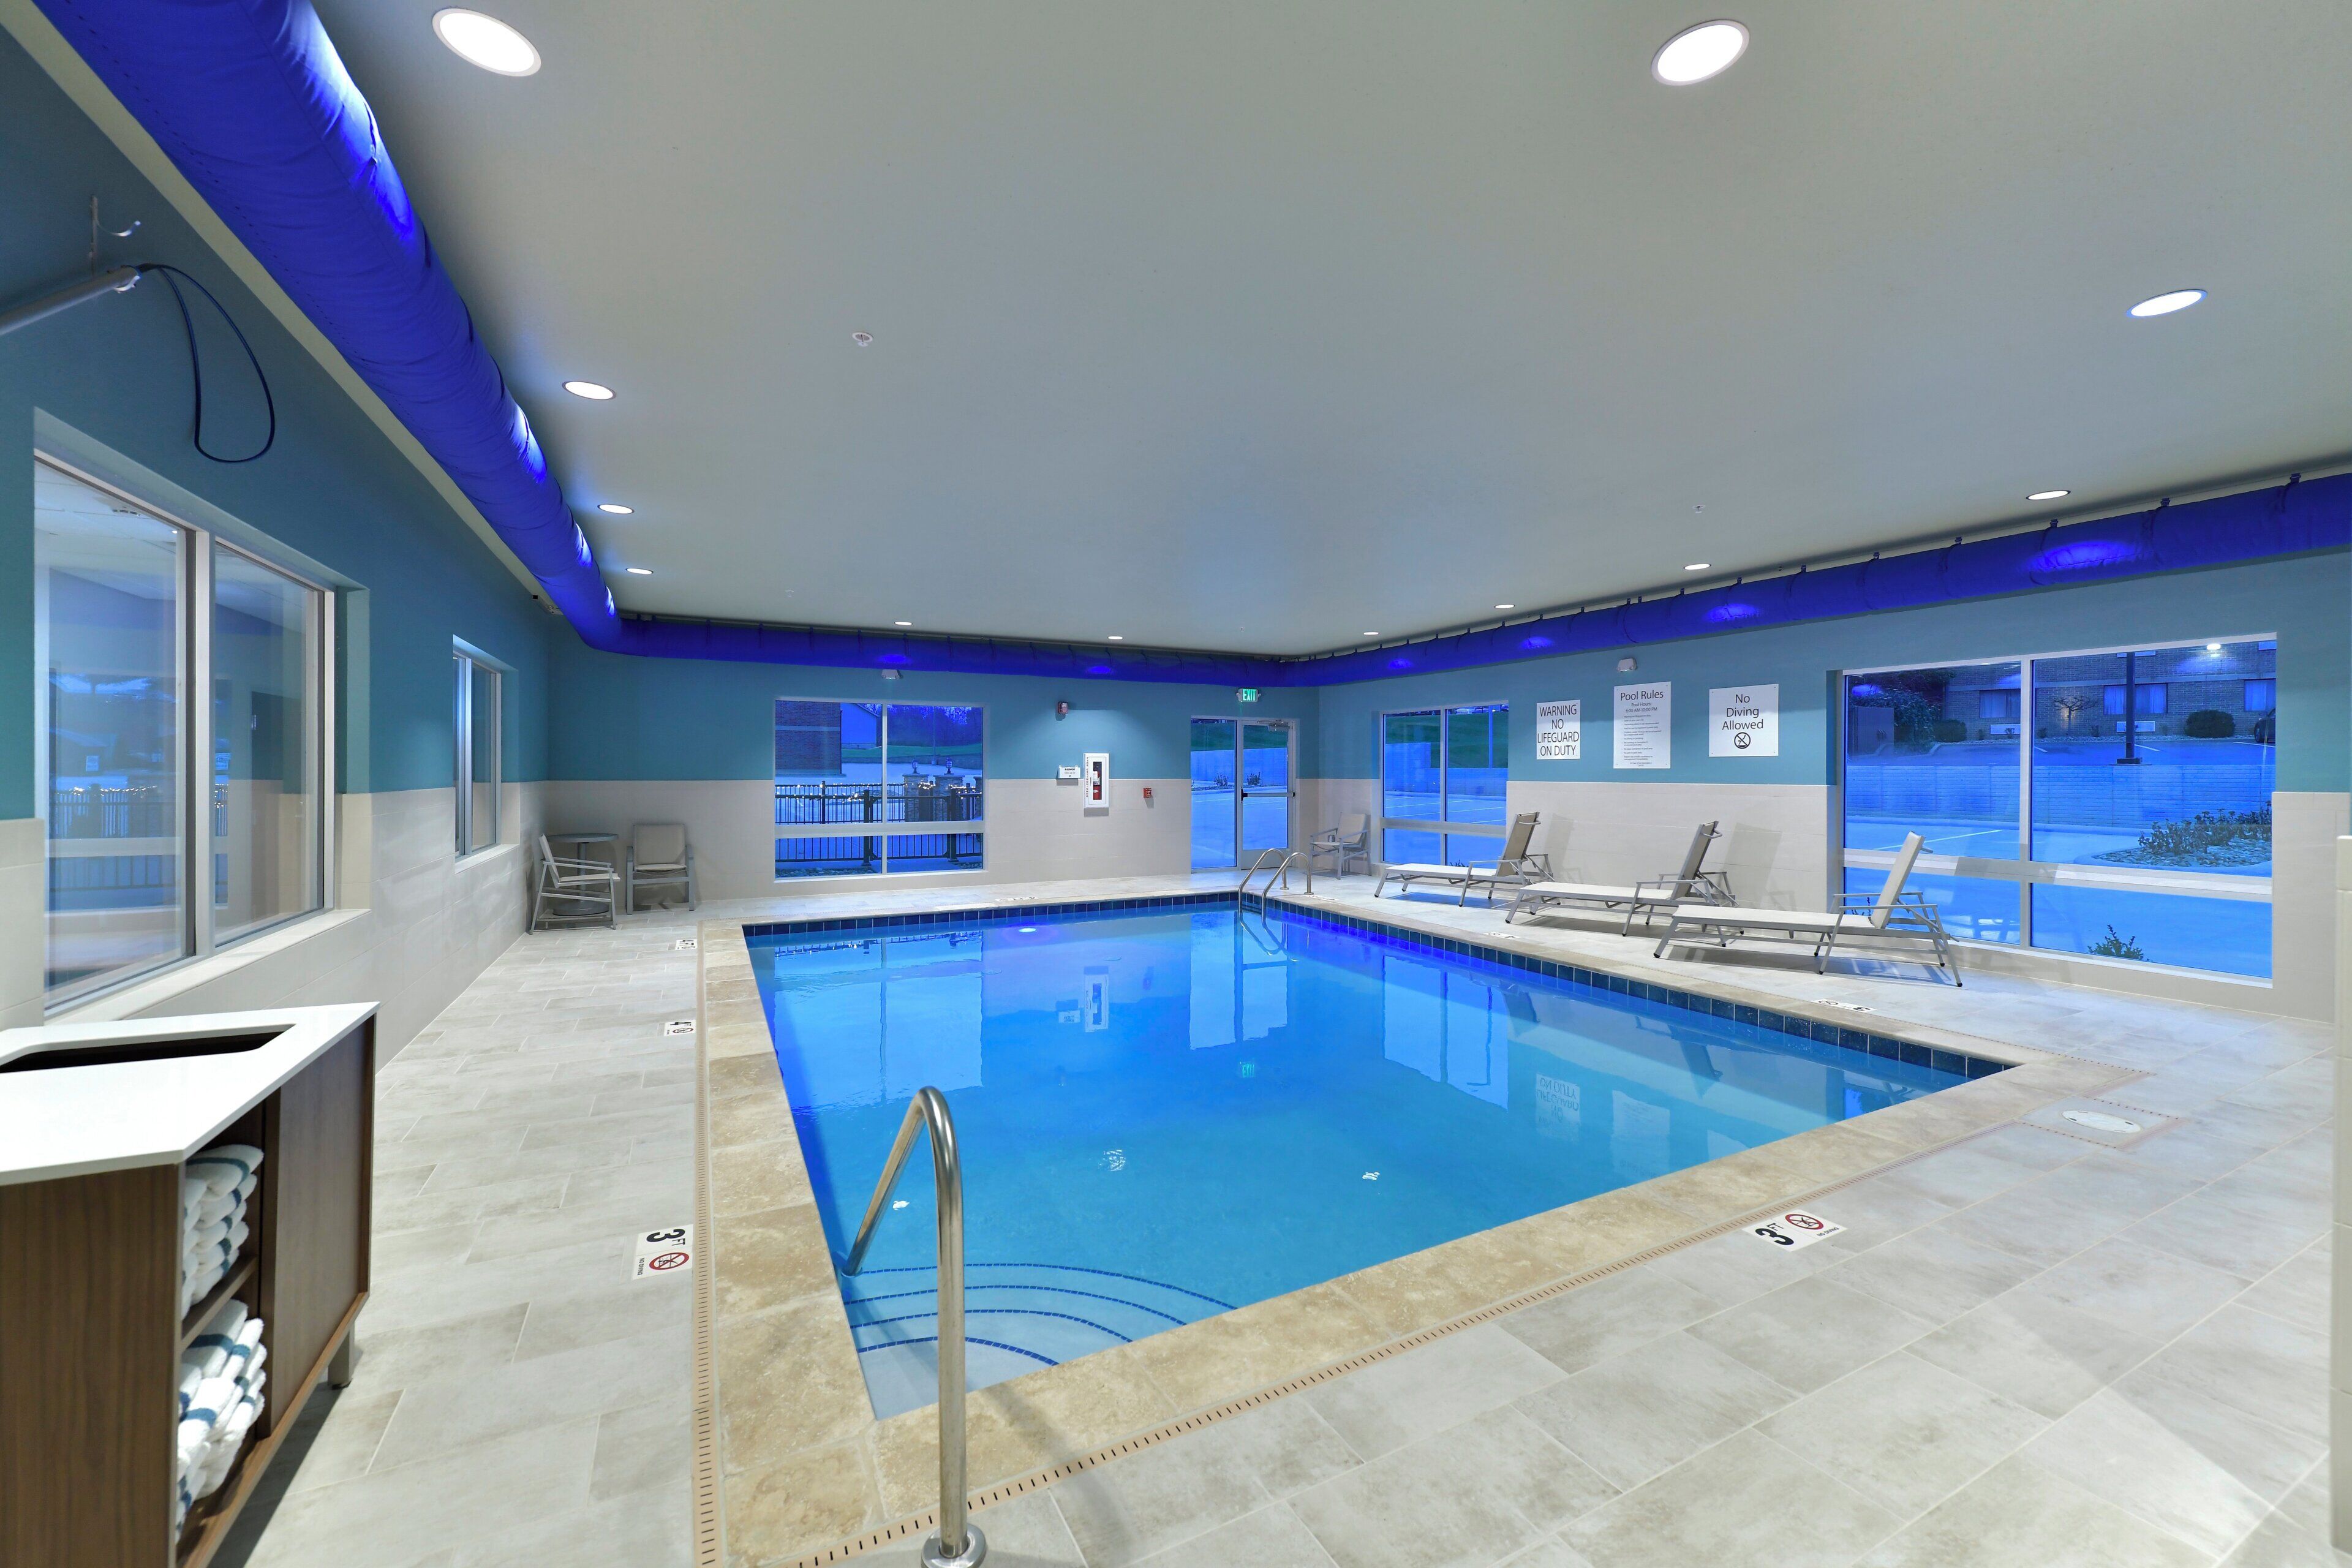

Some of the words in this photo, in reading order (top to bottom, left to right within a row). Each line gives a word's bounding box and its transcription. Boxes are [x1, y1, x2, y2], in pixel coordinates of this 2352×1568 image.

[1243, 688, 1256, 701] EXIT
[1620, 690, 1638, 701] Pool
[1641, 690, 1664, 699] Rules
[1735, 694, 1750, 703] No
[1539, 704, 1577, 717] WARNING
[1726, 707, 1759, 718] Diving
[1551, 718, 1564, 729] NO
[1722, 718, 1763, 731] Allowed
[1537, 731, 1580, 743] LIFEGUARD
[1540, 745, 1552, 756] ON
[1554, 745, 1577, 756] DUTY
[1766, 1223, 1784, 1231] FT
[646, 1229, 685, 1243] 3
[1755, 1228, 1795, 1246] 3
